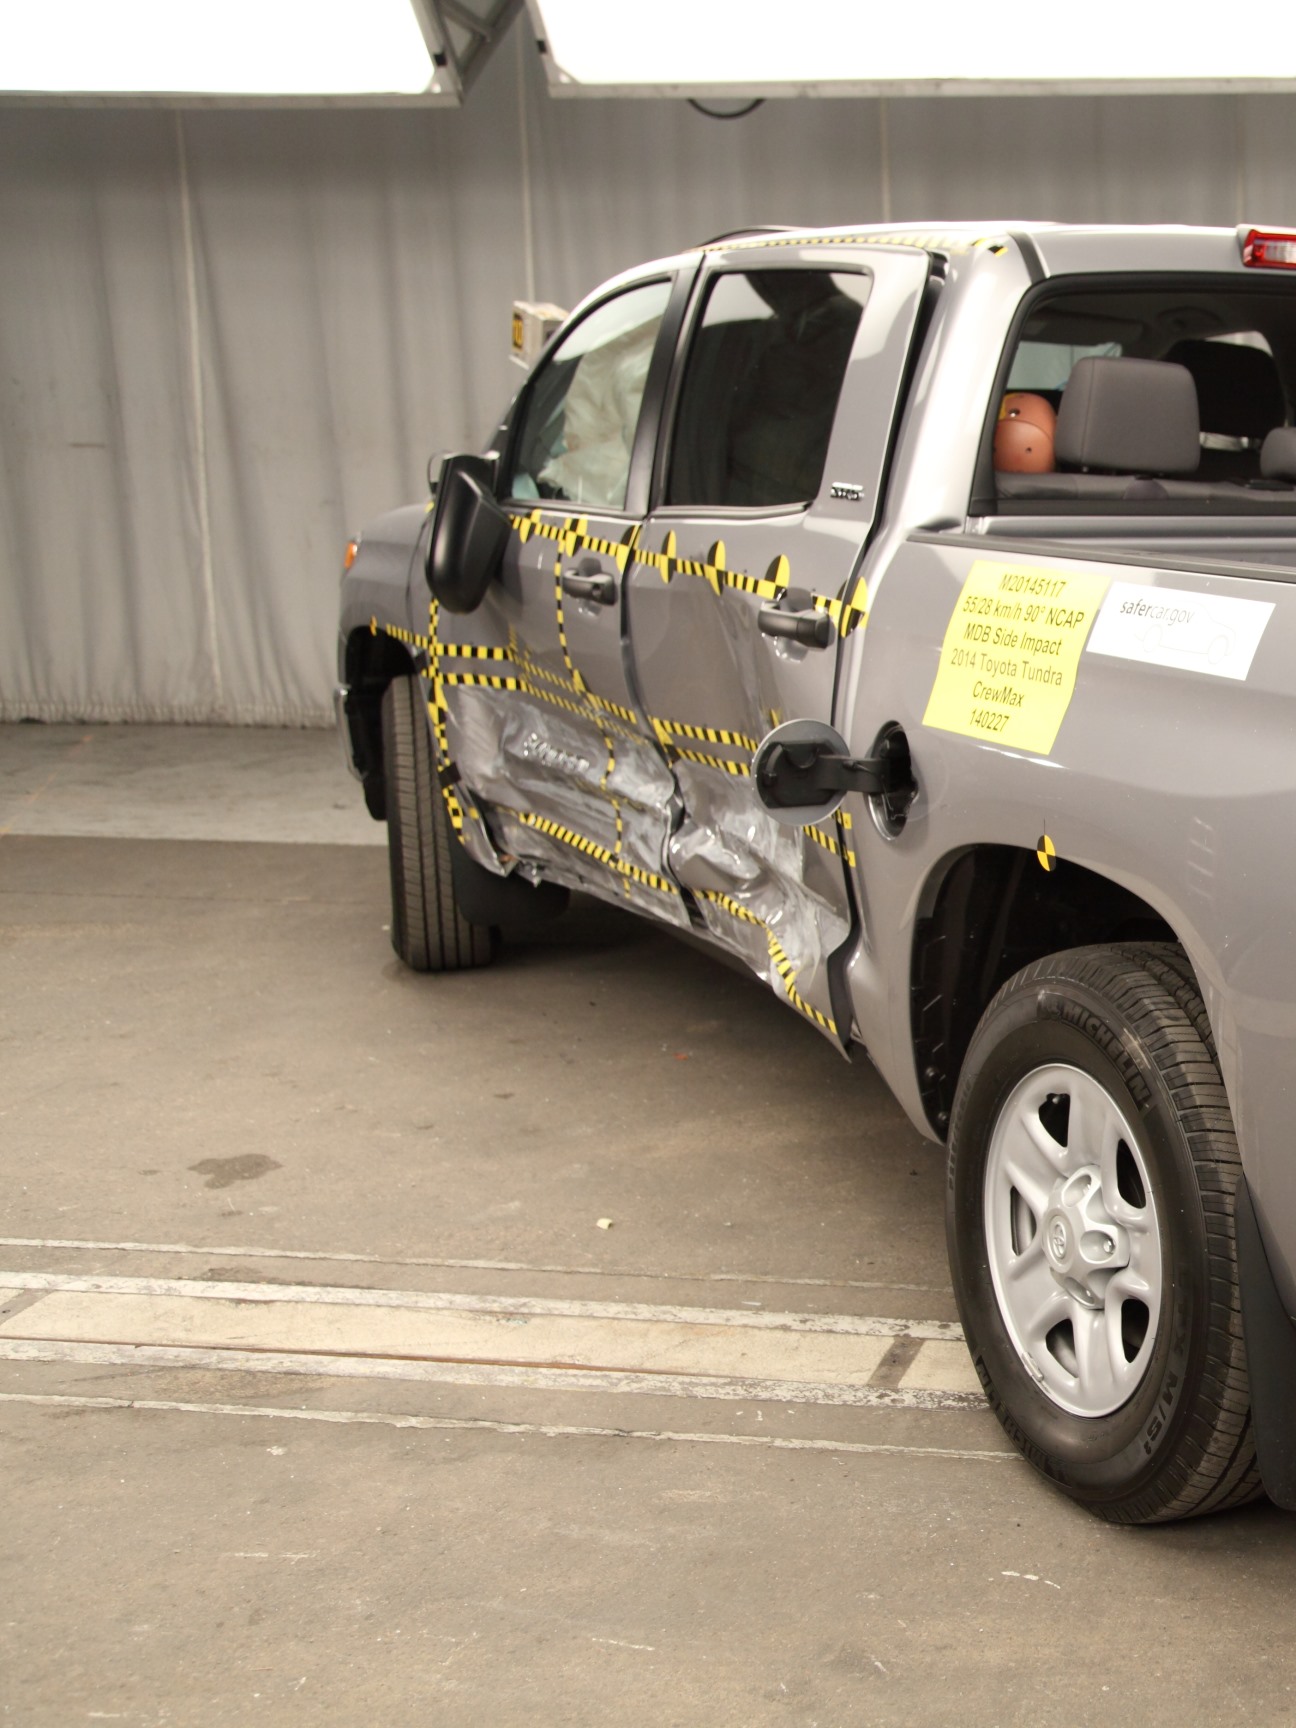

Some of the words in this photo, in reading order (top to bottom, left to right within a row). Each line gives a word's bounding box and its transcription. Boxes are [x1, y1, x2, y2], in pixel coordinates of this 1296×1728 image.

[999, 573, 1067, 598] M20145117
[962, 595, 992, 615] 55/28
[994, 599, 1022, 619] km/h
[1046, 608, 1085, 630] NCAP
[1119, 597, 1196, 626] safercar.gov
[963, 622, 992, 644] MDB
[995, 627, 1018, 649] Side
[1020, 632, 1062, 656] Impact
[951, 647, 976, 669] 2014
[980, 653, 1018, 678] Toyota
[1021, 660, 1063, 686] Tundra
[972, 680, 1025, 708] CrewMax
[969, 708, 1010, 733] 140227
[1060, 999, 1152, 1103] MICHELIN
